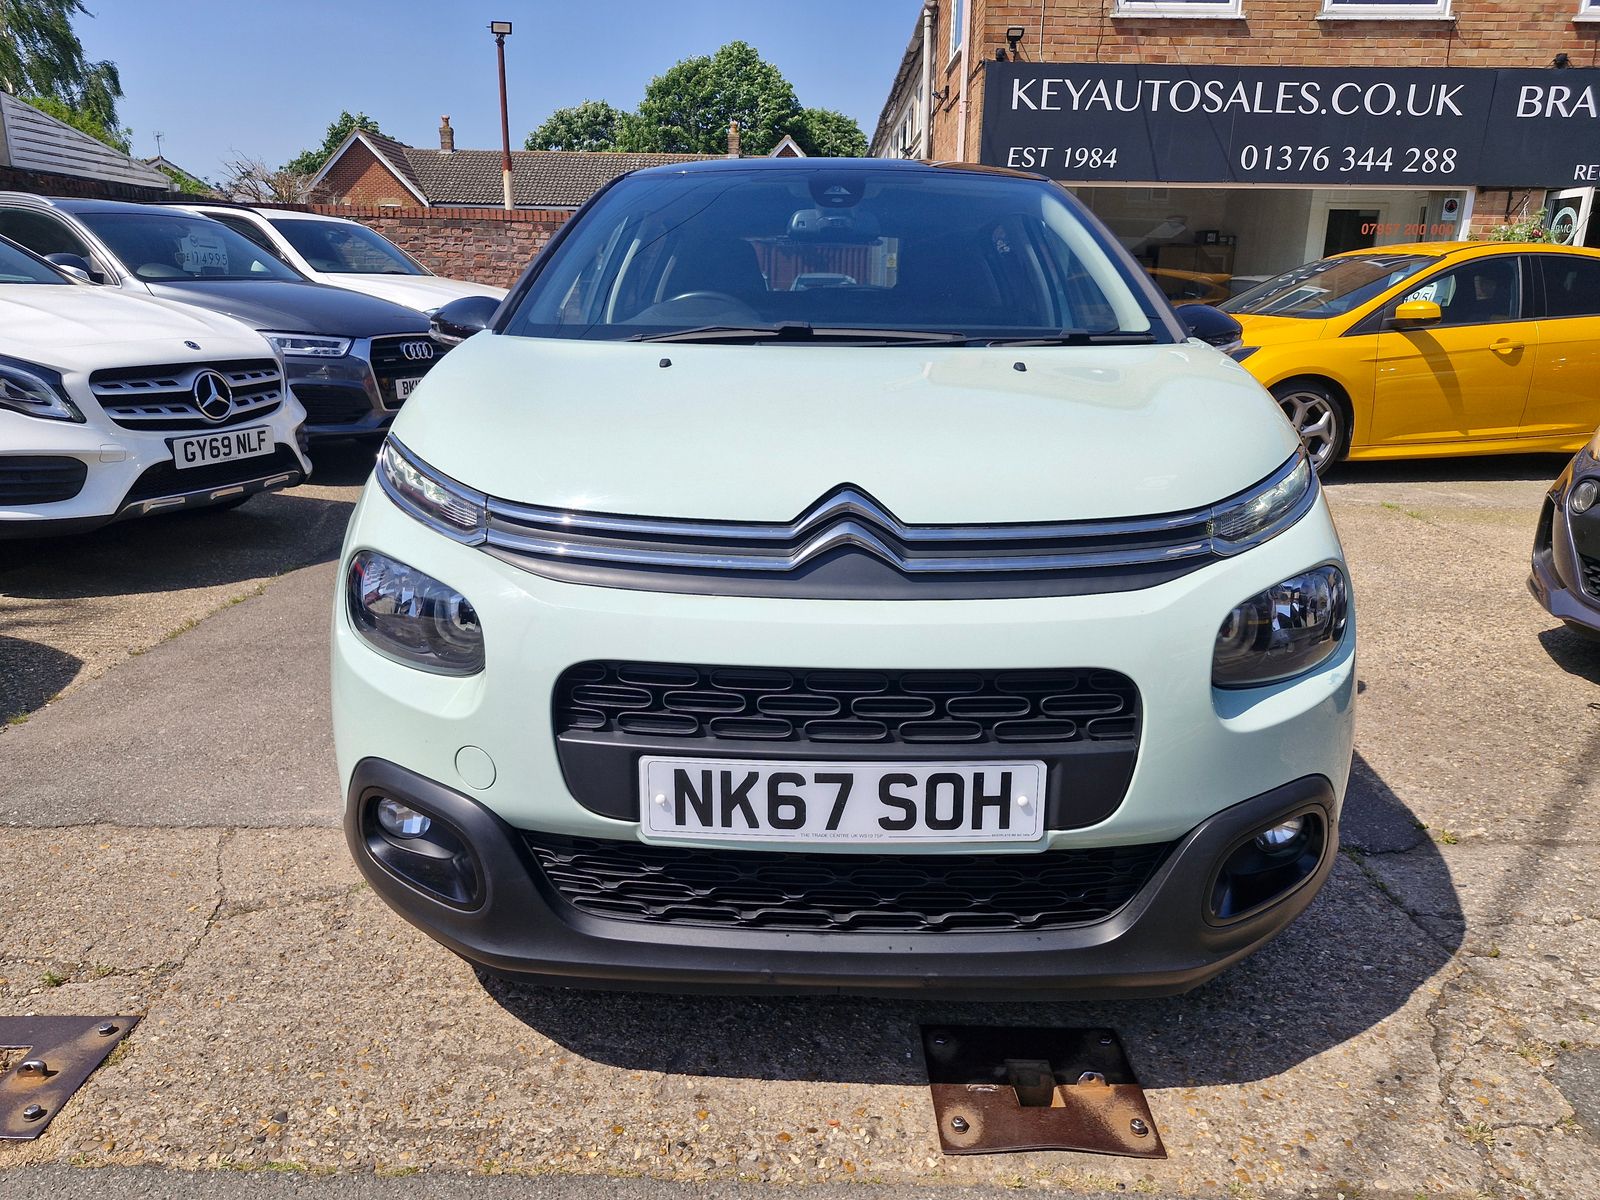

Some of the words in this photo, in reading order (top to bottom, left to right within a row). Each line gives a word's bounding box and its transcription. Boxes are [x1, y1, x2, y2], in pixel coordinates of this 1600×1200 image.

[1011, 78, 1465, 117] KEYAUTOSALES.CO.UK
[1007, 147, 1054, 168] EST
[1064, 147, 1118, 169] 1984
[1240, 145, 1331, 171] 01376
[1339, 146, 1393, 172] 344
[1402, 147, 1458, 174] 288
[1574, 164, 1600, 180] RE
[1404, 223, 1427, 237] 200
[183, 436, 232, 462] GY69
[236, 430, 266, 454] NLF
[674, 769, 854, 830] NK67
[878, 772, 1012, 830] SOH
